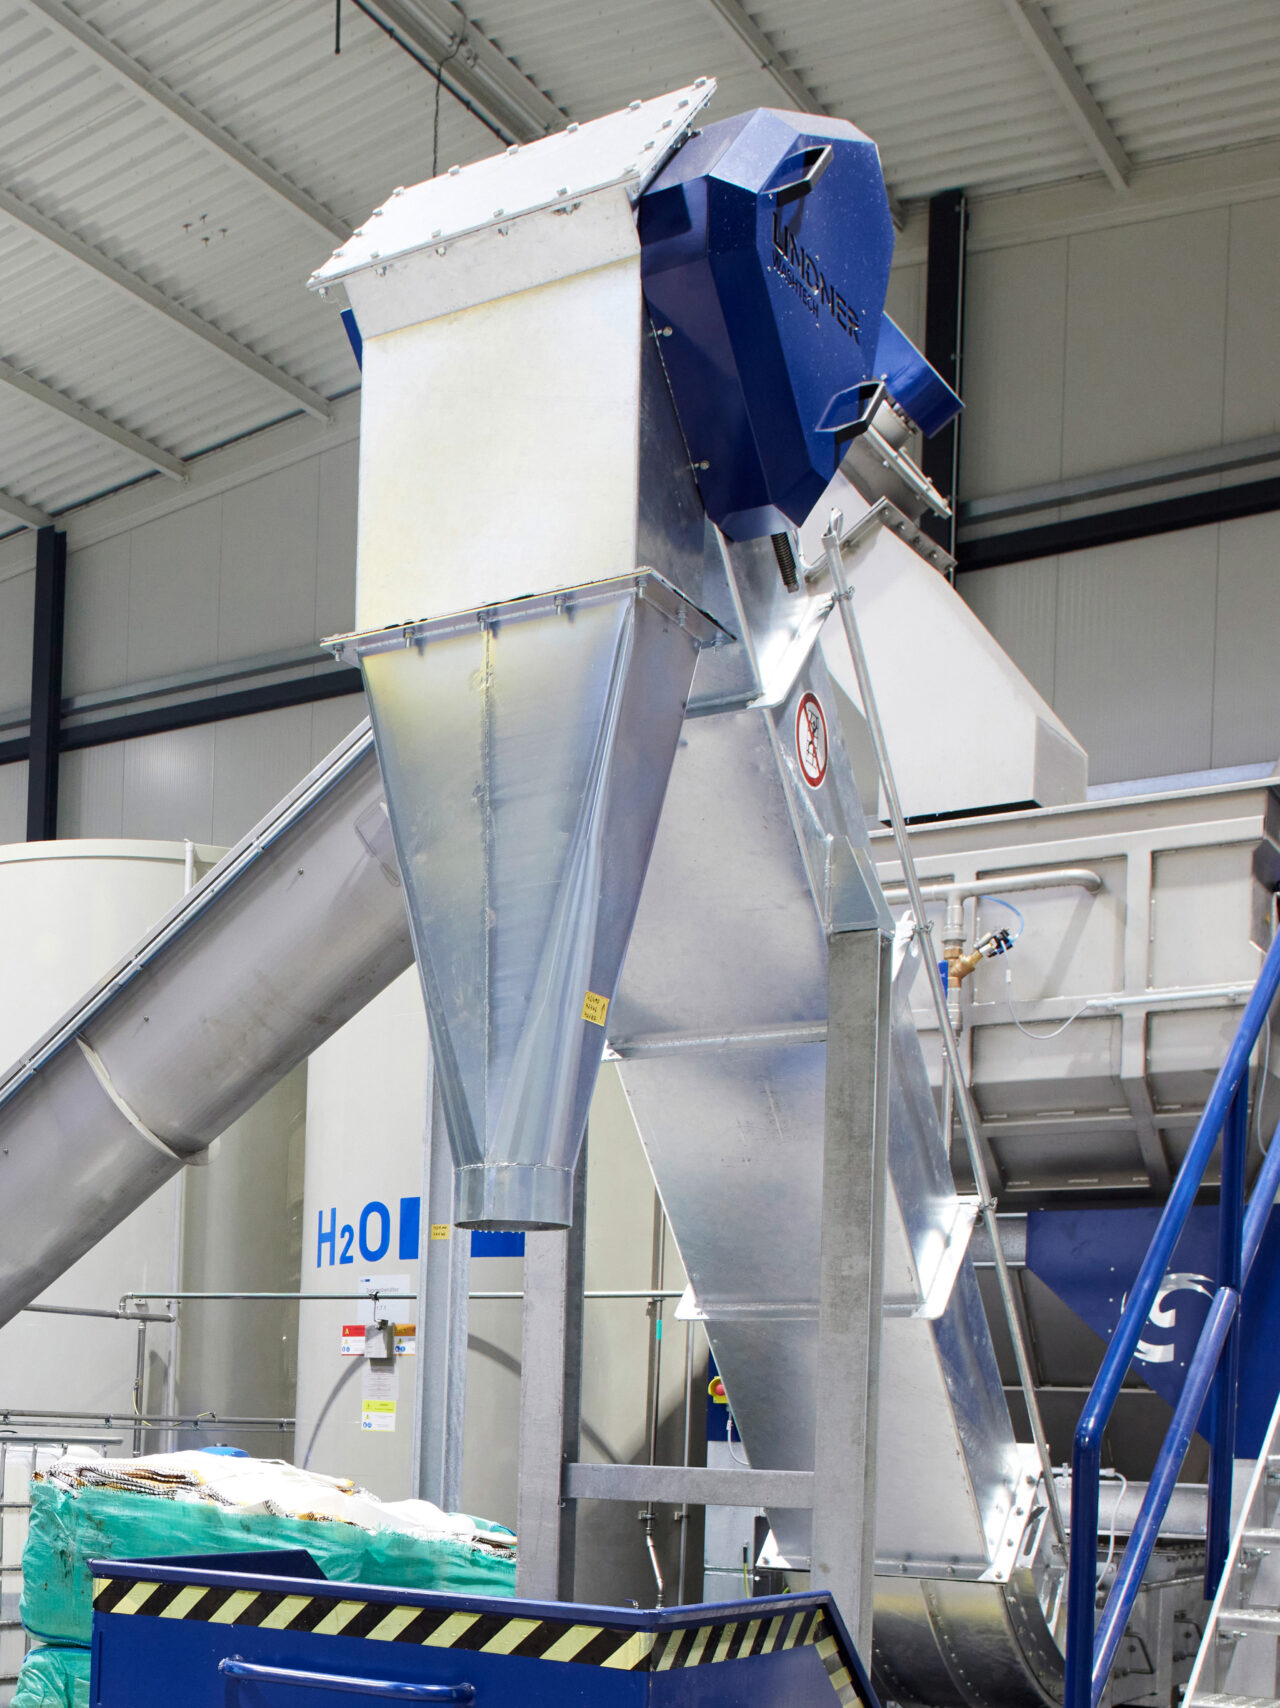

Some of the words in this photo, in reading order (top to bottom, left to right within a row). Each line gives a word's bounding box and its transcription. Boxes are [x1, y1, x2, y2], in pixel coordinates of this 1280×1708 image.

[772, 211, 860, 345] LINDNER
[772, 250, 819, 319] WASHTECH
[317, 1200, 391, 1268] H2O
